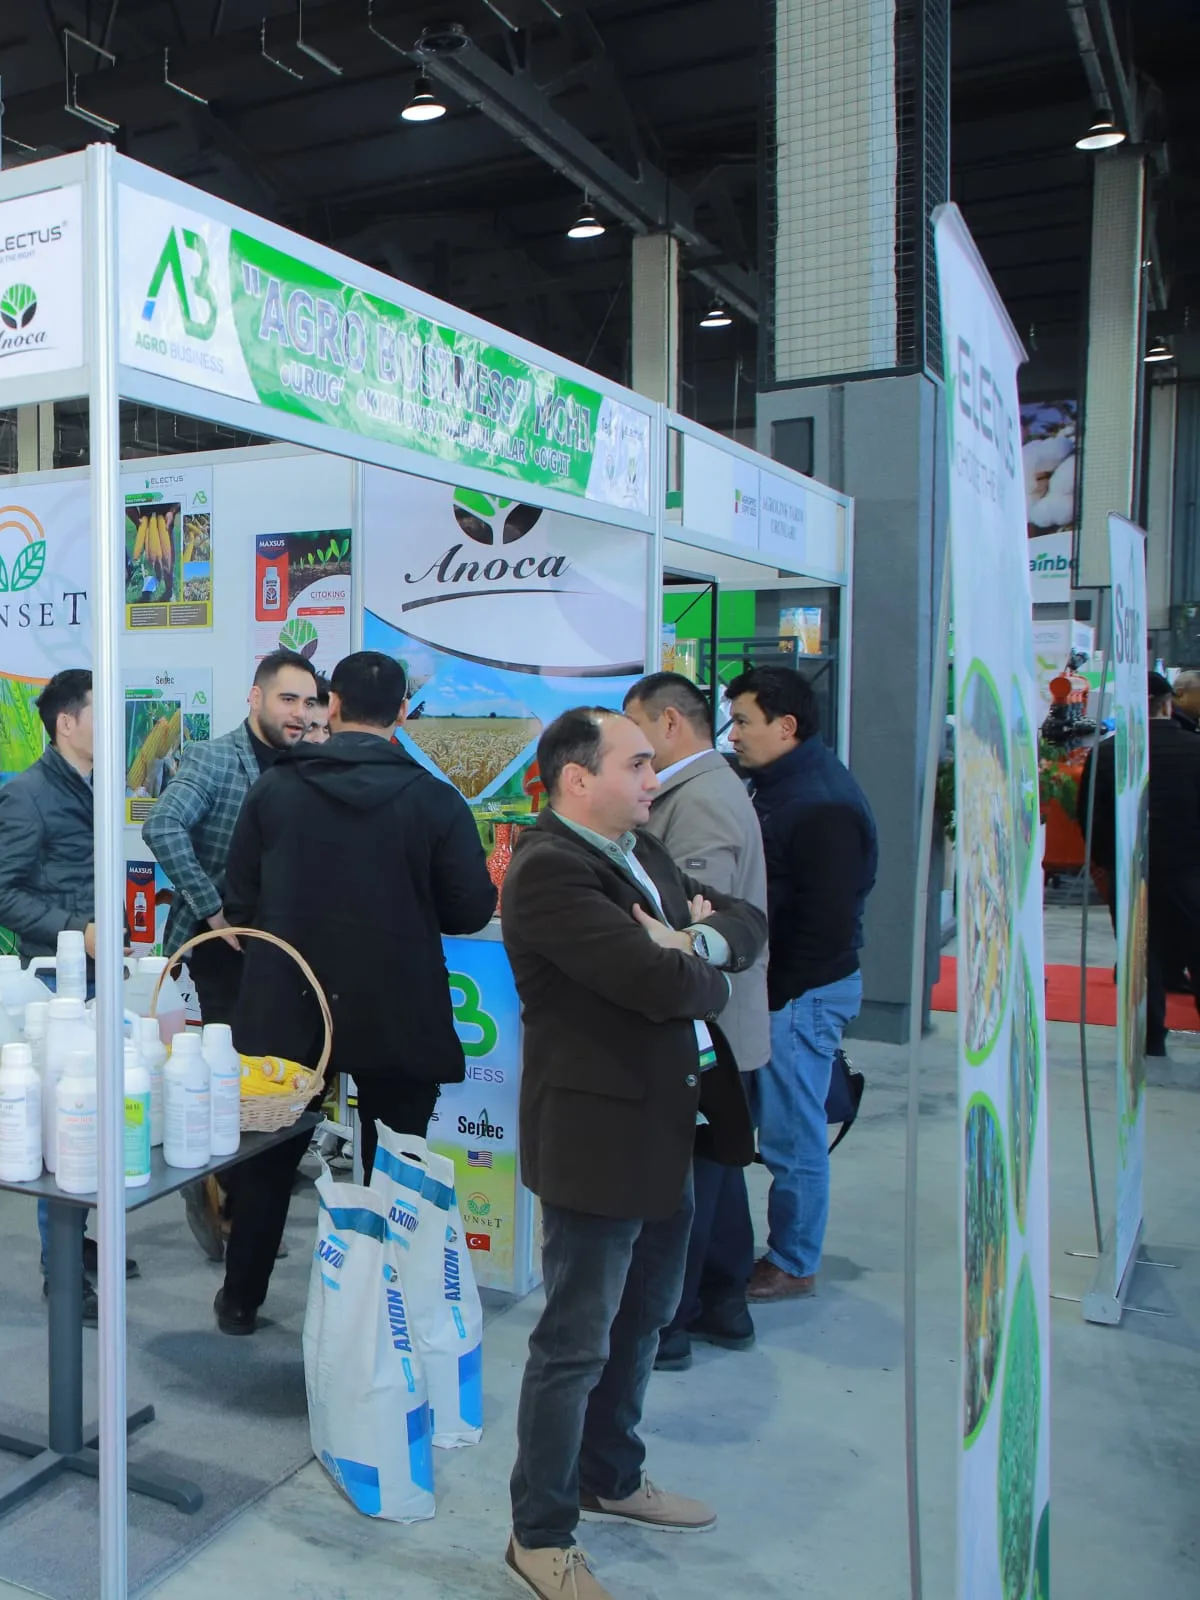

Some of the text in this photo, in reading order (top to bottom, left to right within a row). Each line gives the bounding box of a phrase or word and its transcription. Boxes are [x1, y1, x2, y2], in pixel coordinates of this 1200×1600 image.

[135, 331, 223, 374] AGRO BUSINESS
[533, 389, 590, 452] MCHJ
[151, 475, 183, 485] ELECTUS
[404, 544, 572, 584] Anoca
[310, 591, 346, 599] CITOKING
[129, 866, 153, 875] MAXSUS
[458, 1115, 504, 1139] Seitec
[388, 1206, 419, 1234] AXION
[464, 1214, 503, 1229] UNSET
[444, 1248, 462, 1301] AXION
[386, 1288, 413, 1353] AXION
